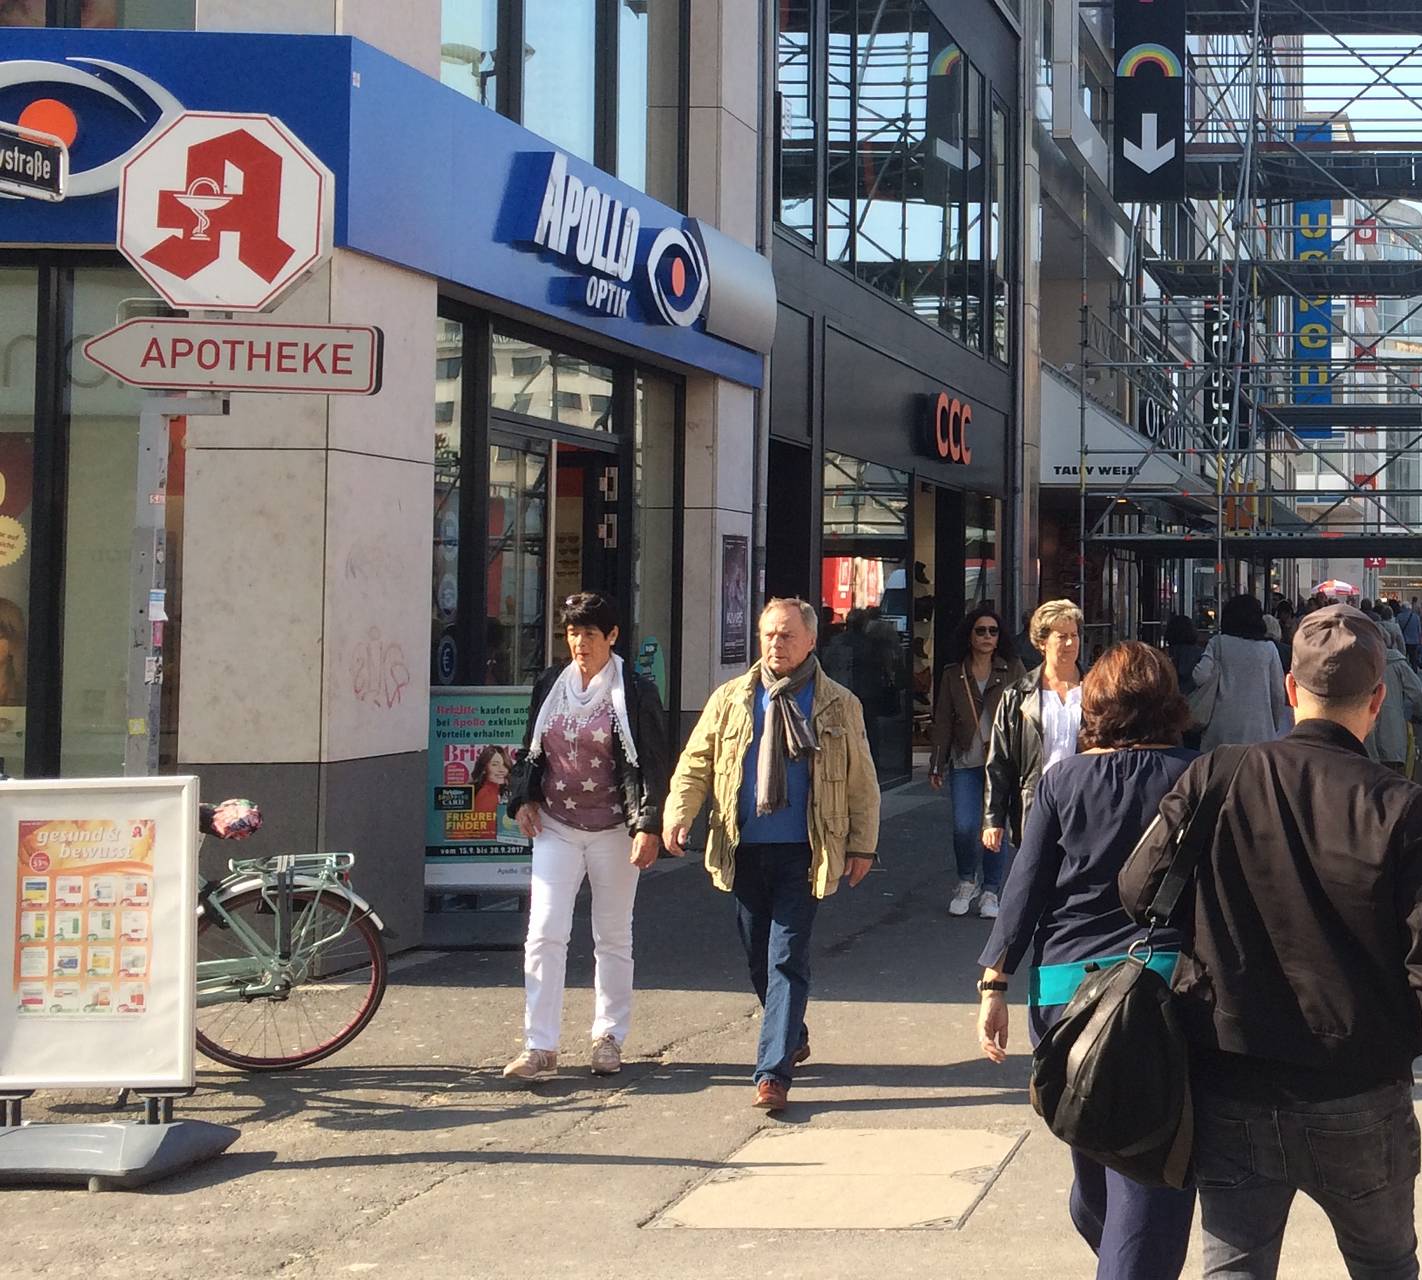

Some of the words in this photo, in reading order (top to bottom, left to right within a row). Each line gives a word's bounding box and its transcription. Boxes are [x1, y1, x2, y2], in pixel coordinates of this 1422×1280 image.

[533, 151, 641, 283] APOLLO
[586, 275, 632, 319] OPTIK
[139, 336, 355, 376] APOTHEKE
[935, 390, 973, 465] CCC
[480, 705, 511, 715] kaufen
[436, 718, 451, 727] bei
[436, 729, 471, 739] Vorteile
[473, 729, 514, 738] erhalten!
[445, 821, 488, 831] FINDER
[36, 828, 103, 846] gesund
[107, 829, 121, 842] &
[59, 843, 133, 859] bewusst
[440, 847, 457, 855] vom
[476, 847, 488, 855] bis
